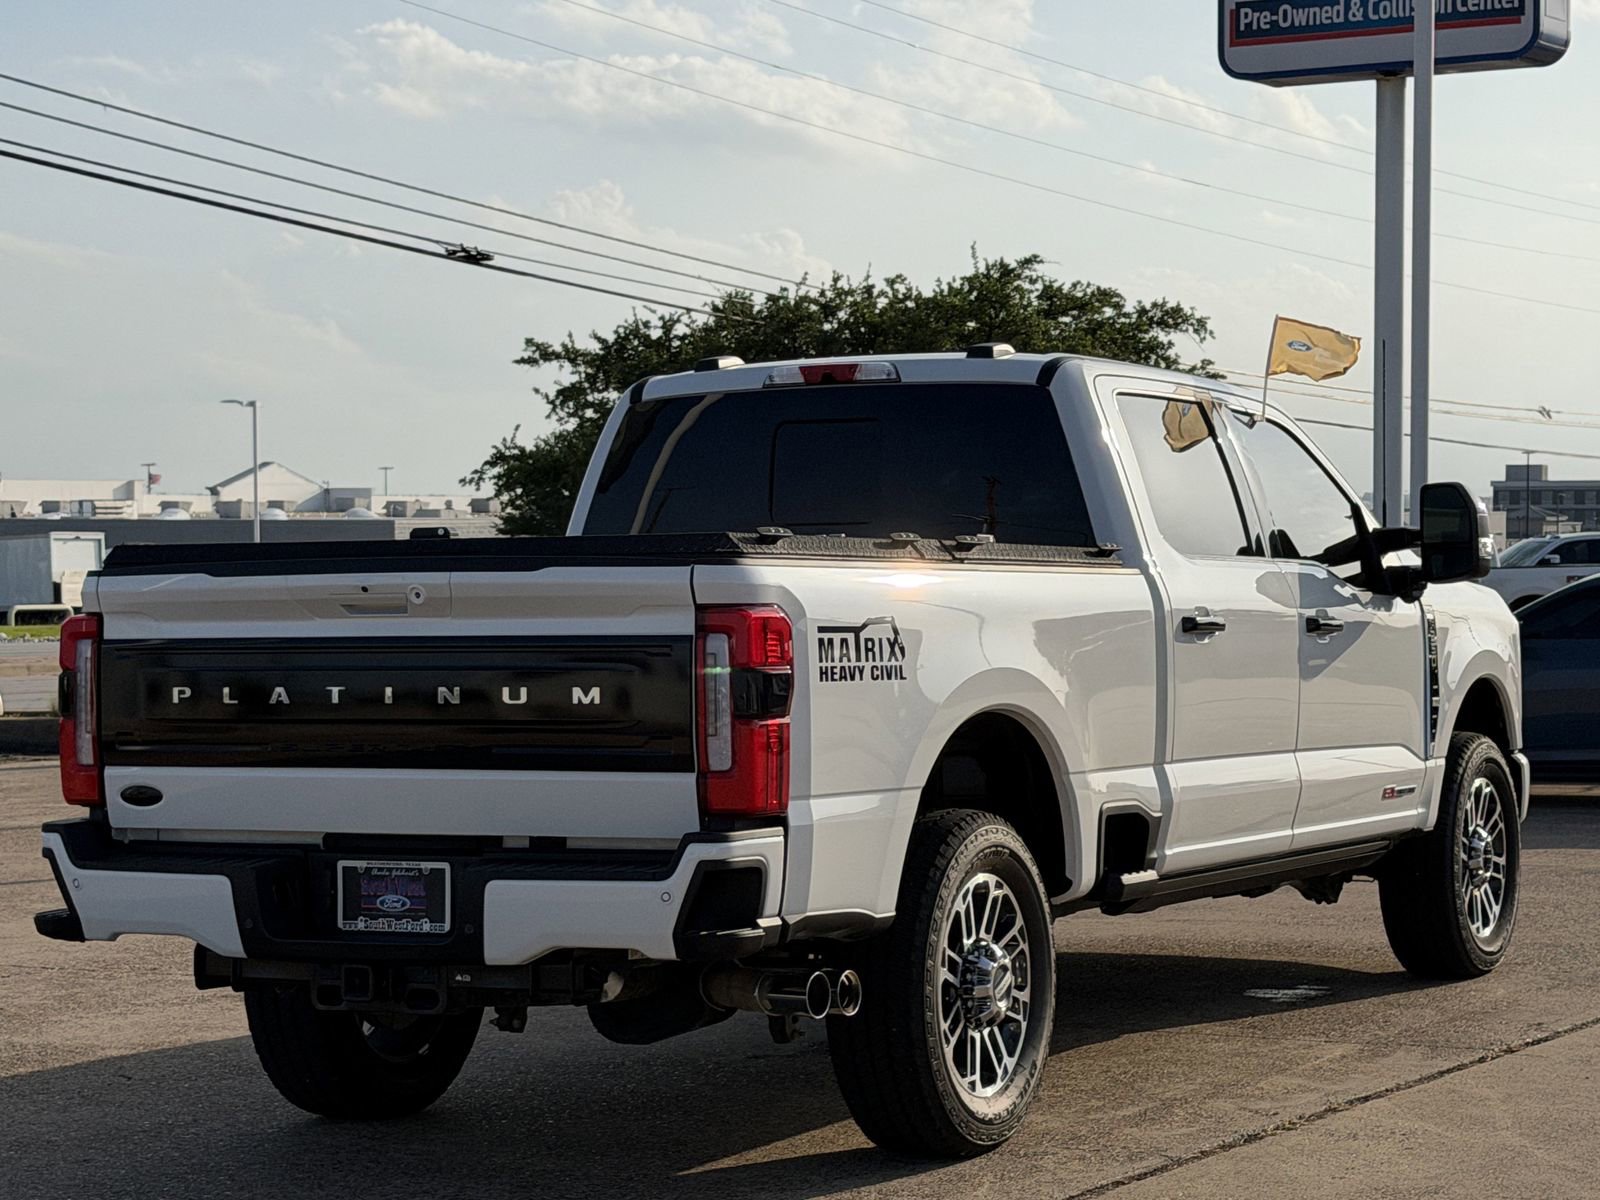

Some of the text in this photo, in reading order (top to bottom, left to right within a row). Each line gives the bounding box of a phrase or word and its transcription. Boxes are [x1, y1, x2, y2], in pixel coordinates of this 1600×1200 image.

[1239, 0, 1345, 31] Pre-Owned
[1347, 0, 1364, 22] &
[1367, 0, 1452, 20] Collin
[817, 623, 905, 663] MATRIX
[818, 664, 907, 682] HEAVY CIVIL
[171, 685, 601, 705] PLATINUM
